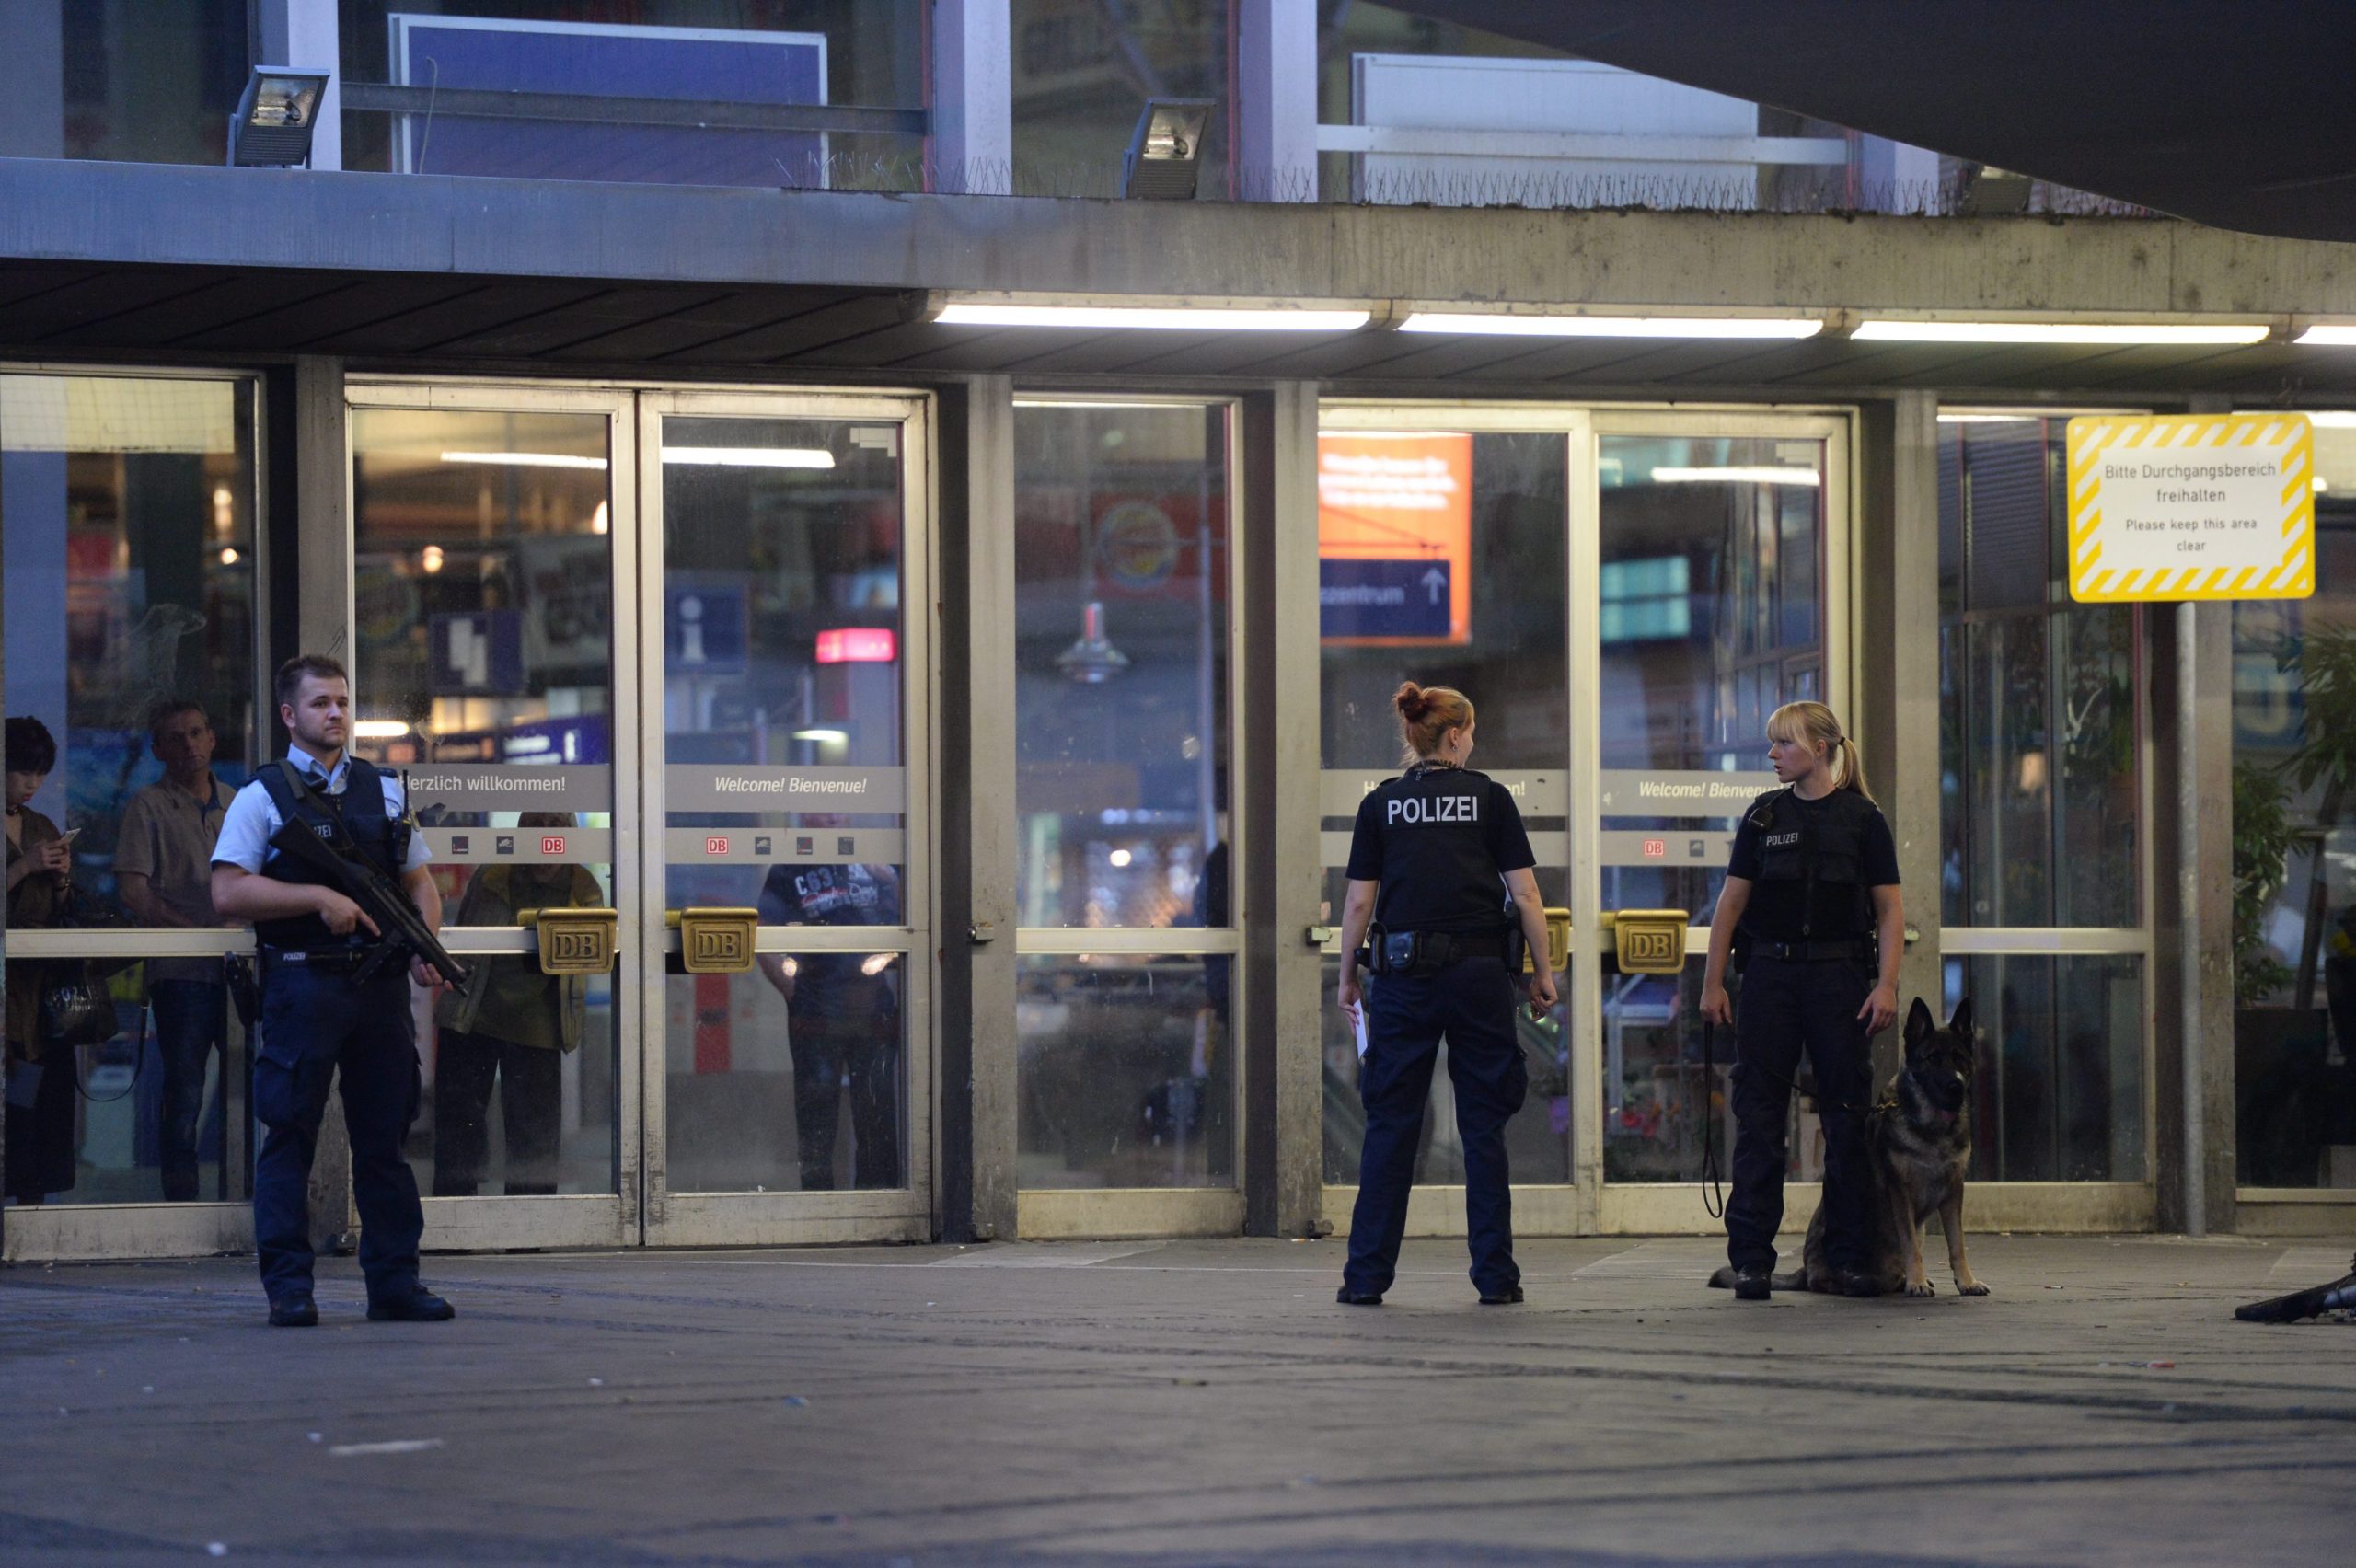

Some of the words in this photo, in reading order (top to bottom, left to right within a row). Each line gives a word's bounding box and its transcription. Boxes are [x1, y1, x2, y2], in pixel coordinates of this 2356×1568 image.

[2105, 464, 2137, 479] Bitte
[2142, 462, 2277, 482] Durchgangsbereich
[2155, 488, 2227, 503] freihalten
[2125, 518, 2166, 532] Please
[2170, 518, 2200, 533] keep
[2203, 517, 2226, 530] this
[2230, 518, 2258, 530] area
[2176, 538, 2206, 552] clear
[467, 775, 566, 792] willkommen!
[714, 776, 785, 793] Welcome!
[788, 777, 868, 794] Bienvenue!
[1639, 781, 1706, 798] Welcome!
[1709, 781, 1784, 799] Bienven
[1387, 795, 1478, 825] POLIZEI
[543, 838, 564, 852] DB
[708, 838, 727, 853] DB
[1765, 831, 1799, 847] POLIZEI
[1645, 841, 1664, 855] DB
[556, 933, 597, 959] DB
[698, 932, 739, 957] DB
[1633, 933, 1670, 958] DB
